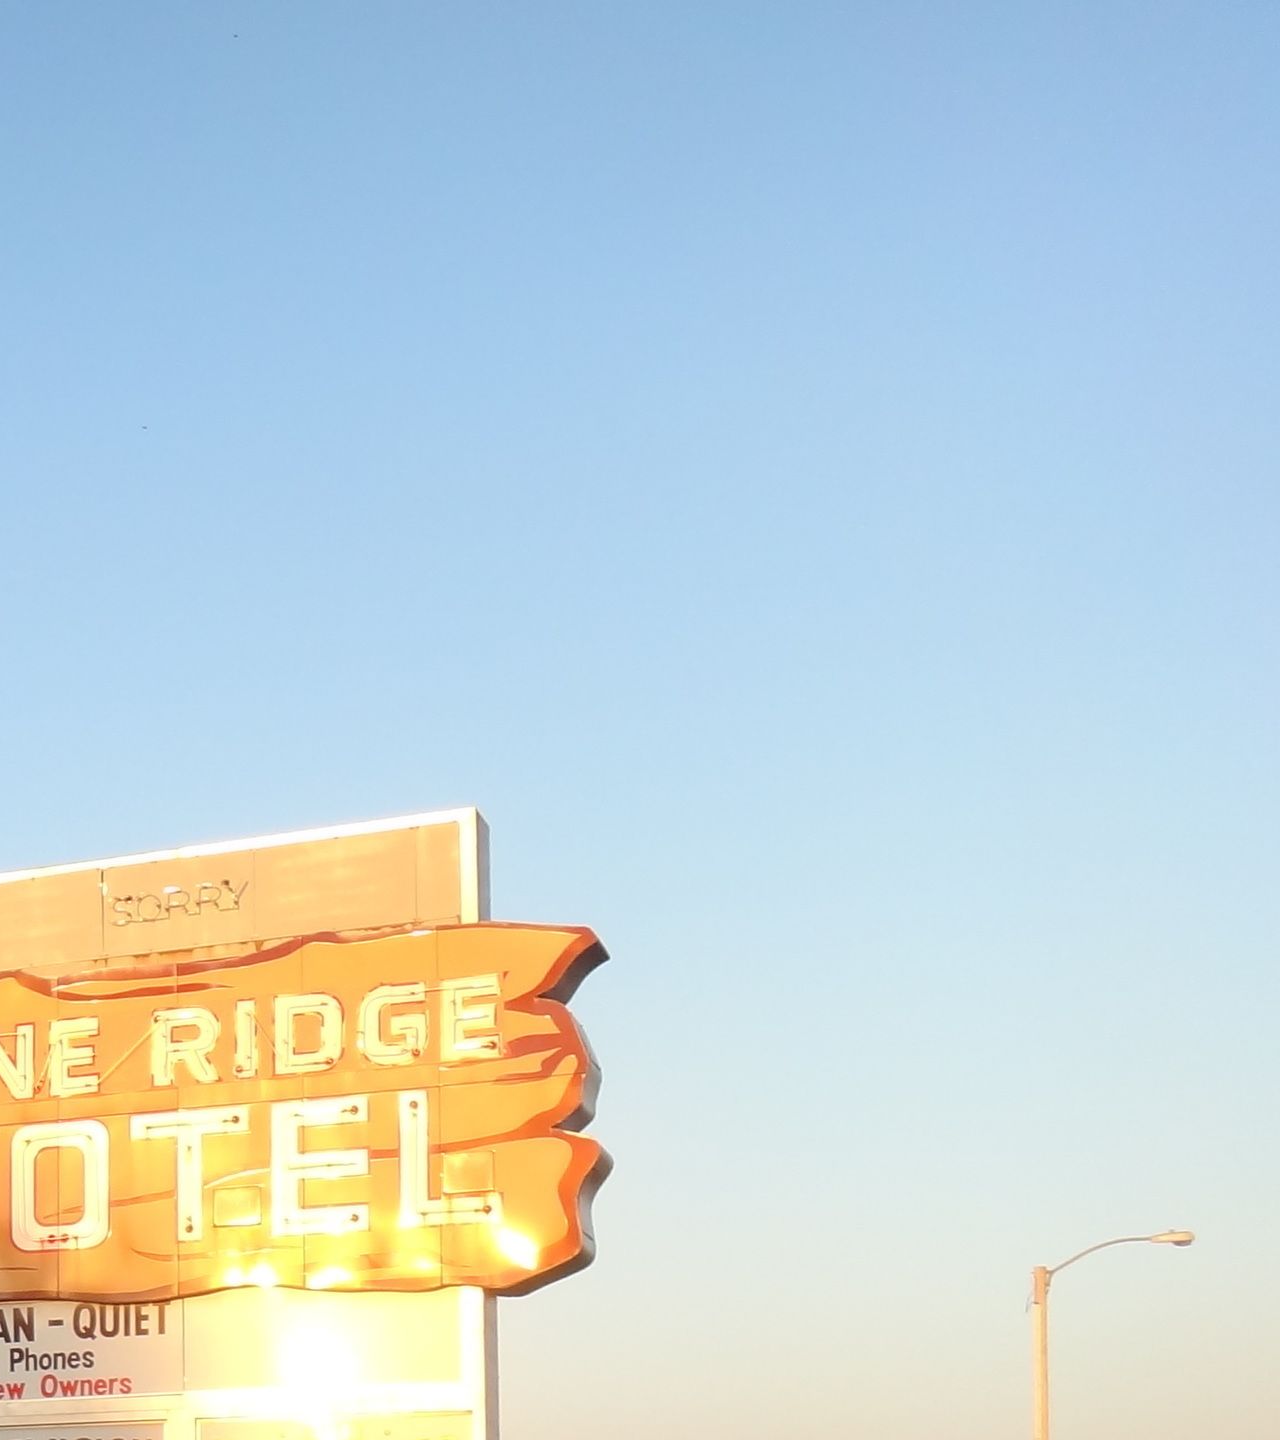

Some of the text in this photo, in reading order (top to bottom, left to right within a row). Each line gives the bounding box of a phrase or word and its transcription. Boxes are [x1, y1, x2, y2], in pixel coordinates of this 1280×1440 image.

[113, 879, 249, 927] SORRY
[151, 972, 503, 1086] RIDGE
[72, 1302, 171, 1341] QUIET
[9, 1347, 95, 1372] Phones
[40, 1373, 133, 1398] Owners
